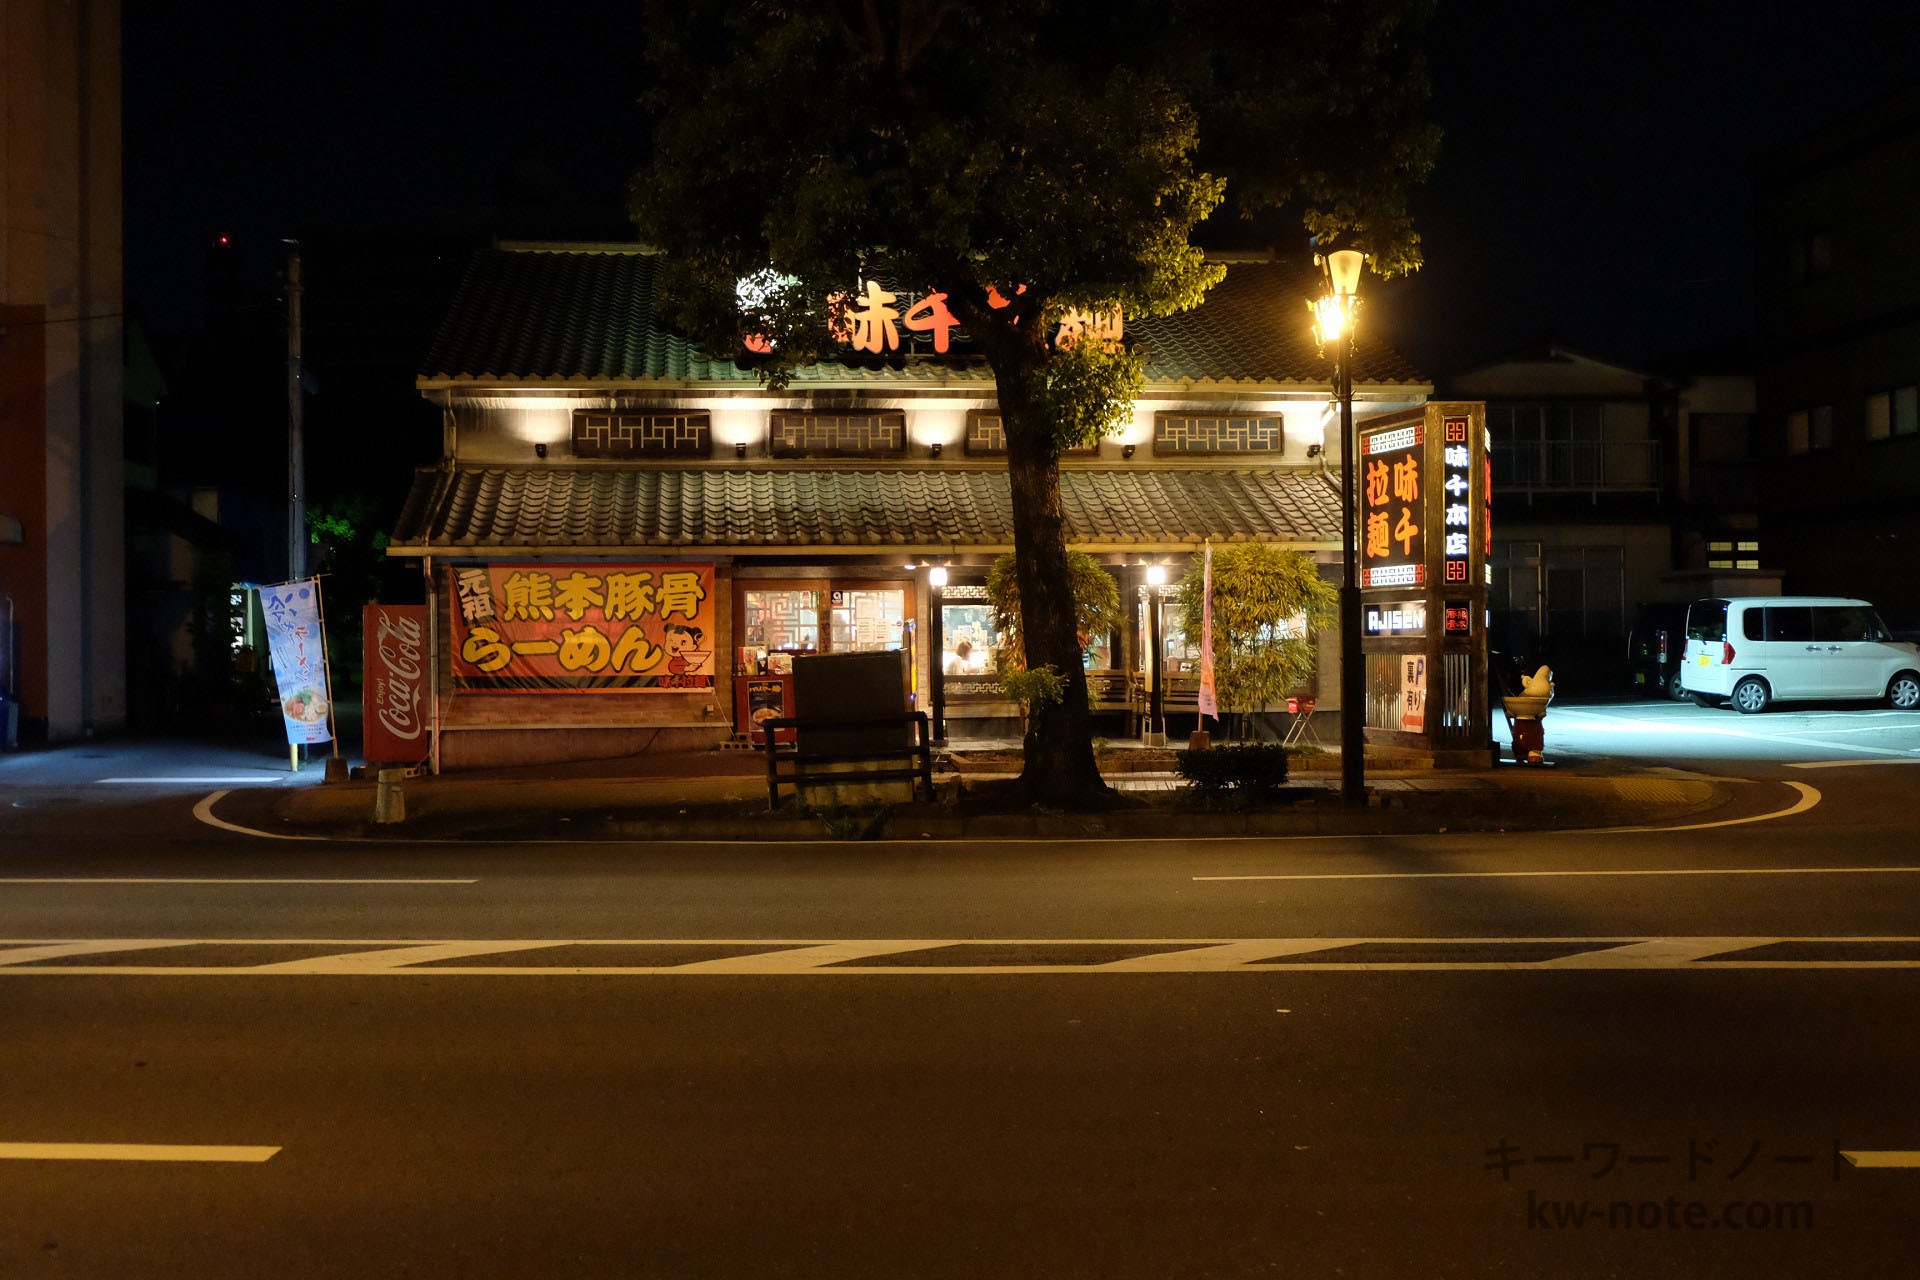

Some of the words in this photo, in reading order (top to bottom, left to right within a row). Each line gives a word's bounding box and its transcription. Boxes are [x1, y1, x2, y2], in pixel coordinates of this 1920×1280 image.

[1393, 453, 1419, 556] 味千
[1444, 444, 1468, 556] 味千本店
[458, 569, 495, 621] 元祖
[501, 571, 705, 622] 熊本豚骨
[1368, 609, 1424, 631] AJISEN
[461, 625, 664, 673] らーめん
